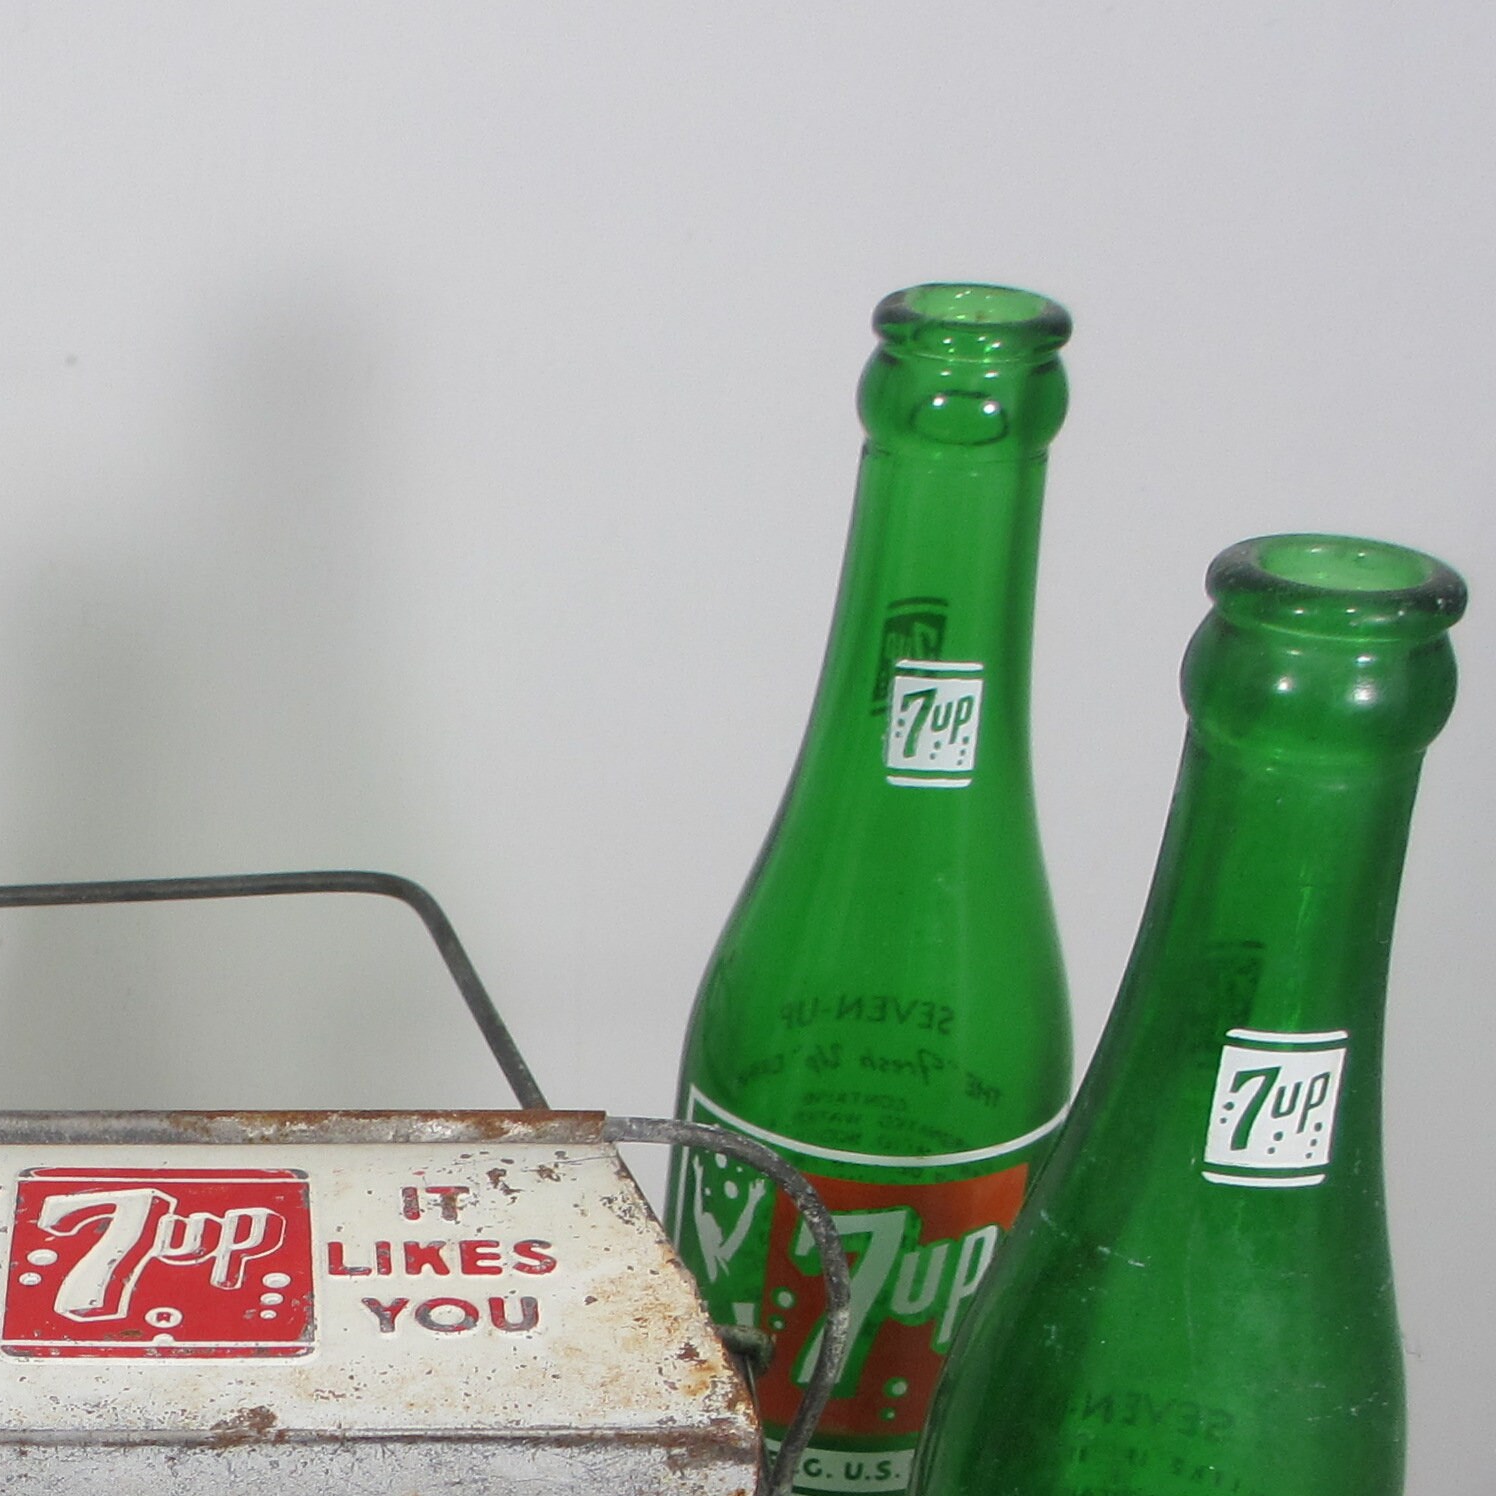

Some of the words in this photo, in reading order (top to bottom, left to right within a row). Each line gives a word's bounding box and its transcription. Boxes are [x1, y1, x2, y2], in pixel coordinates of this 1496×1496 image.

[400, 1184, 471, 1222] IT
[326, 1238, 558, 1277] LIKES
[361, 1295, 541, 1334] YOU
[844, 1459, 900, 1481] U.S.
